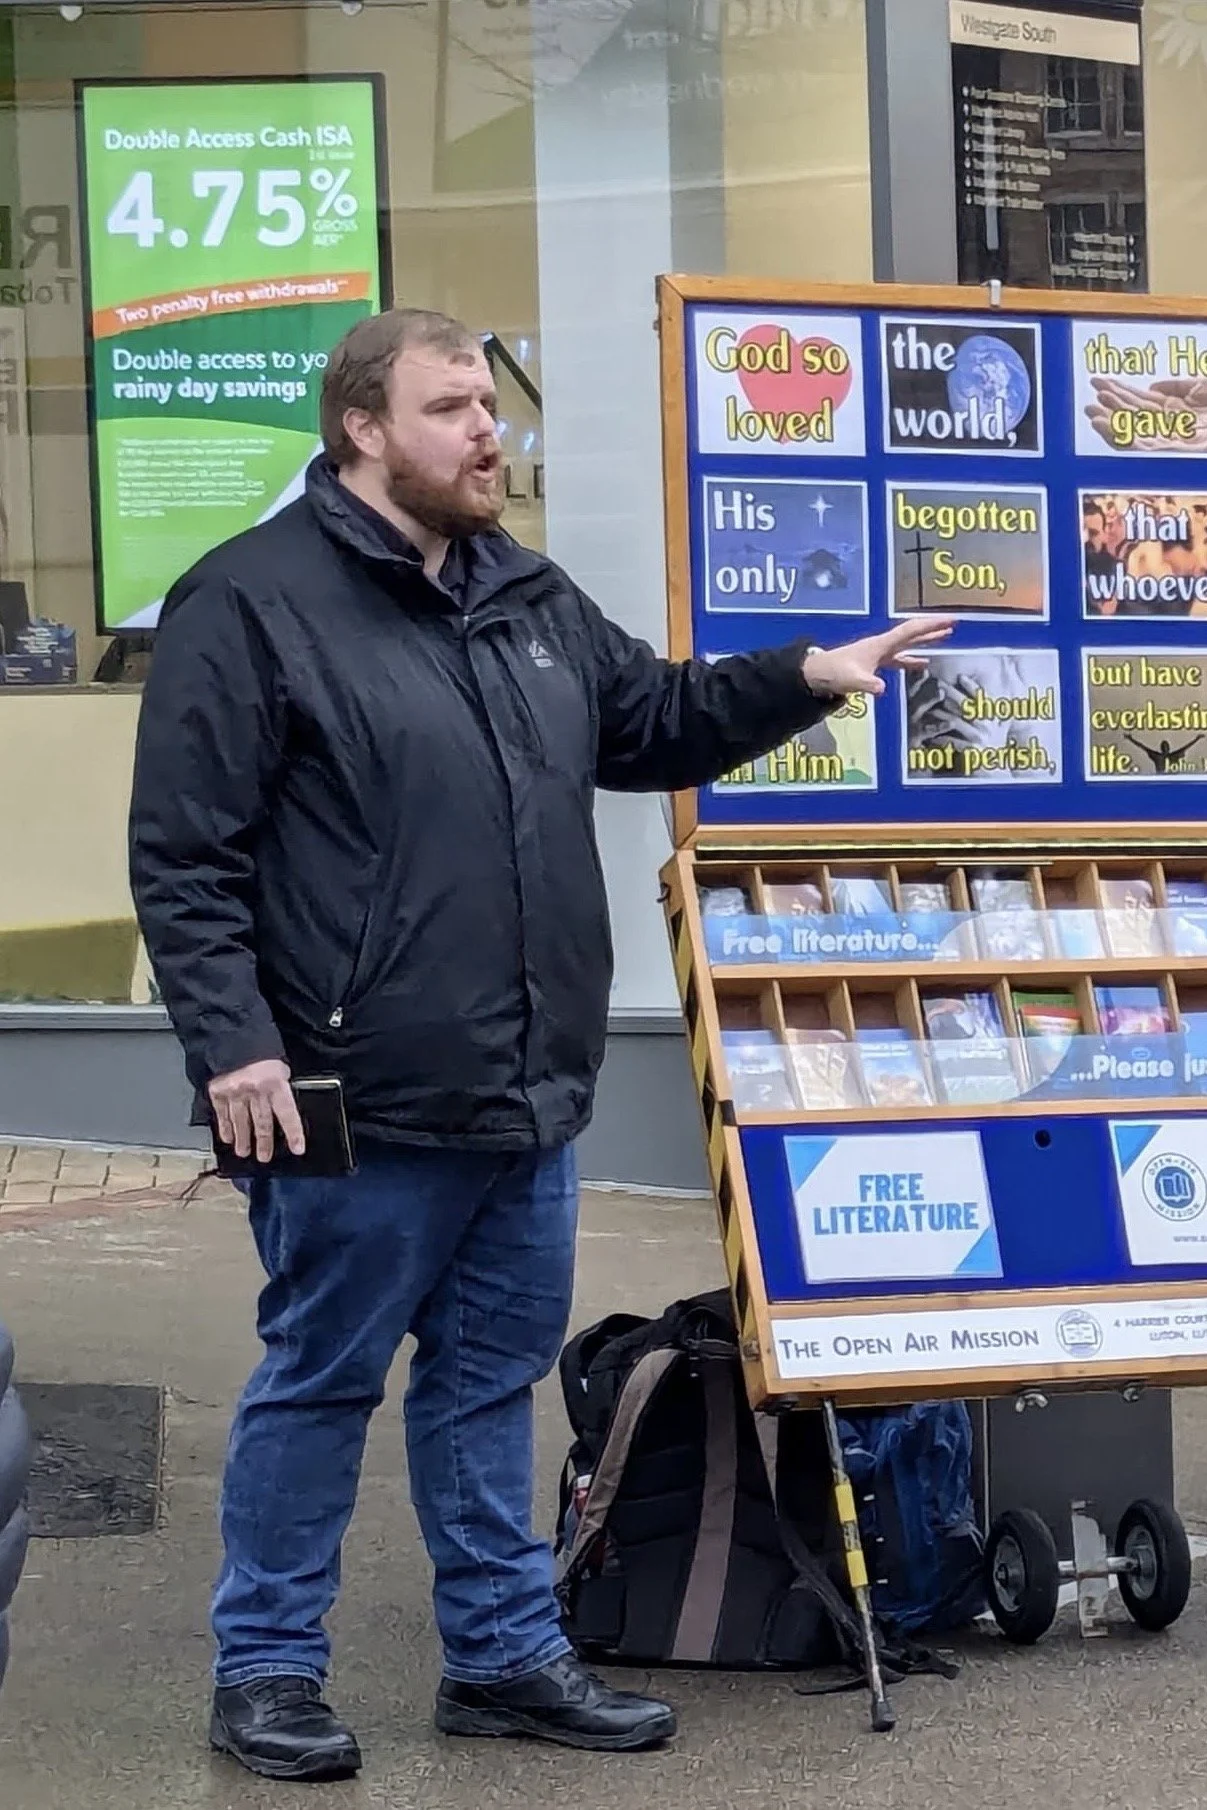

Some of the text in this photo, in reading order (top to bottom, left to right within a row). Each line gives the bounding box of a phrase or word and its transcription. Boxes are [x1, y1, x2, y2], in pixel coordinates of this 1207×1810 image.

[961, 14, 1057, 44] Westgate South
[104, 125, 352, 150] Double Access Cash ISA
[312, 219, 358, 232] GROSS
[115, 308, 148, 324] Two
[151, 294, 208, 321] penalty
[211, 290, 245, 307] free
[113, 349, 328, 372] Double access to yo
[706, 328, 849, 374] God so
[892, 328, 956, 372] the
[1085, 334, 1156, 377] that
[114, 374, 306, 404] rainy day savings
[726, 397, 834, 443] loved
[893, 397, 1018, 447] world,
[1111, 406, 1197, 448] gave
[713, 491, 776, 531] His
[896, 493, 1037, 537] begotten
[1125, 503, 1189, 542] that
[716, 555, 797, 602] only
[933, 551, 1006, 593] Son,
[1089, 656, 1202, 686] but have
[961, 687, 1055, 721] should
[768, 739, 843, 784] Him
[909, 740, 1055, 776] not perish,
[1091, 745, 1140, 774] life.
[1164, 757, 1196, 774] John
[722, 926, 940, 956] Free literature...
[858, 1173, 925, 1203] FREE
[813, 1202, 979, 1236] LITERATURE
[1156, 1202, 1201, 1219] MISSION
[1114, 1320, 1121, 1328] 4
[1125, 1316, 1170, 1327] HARRIER
